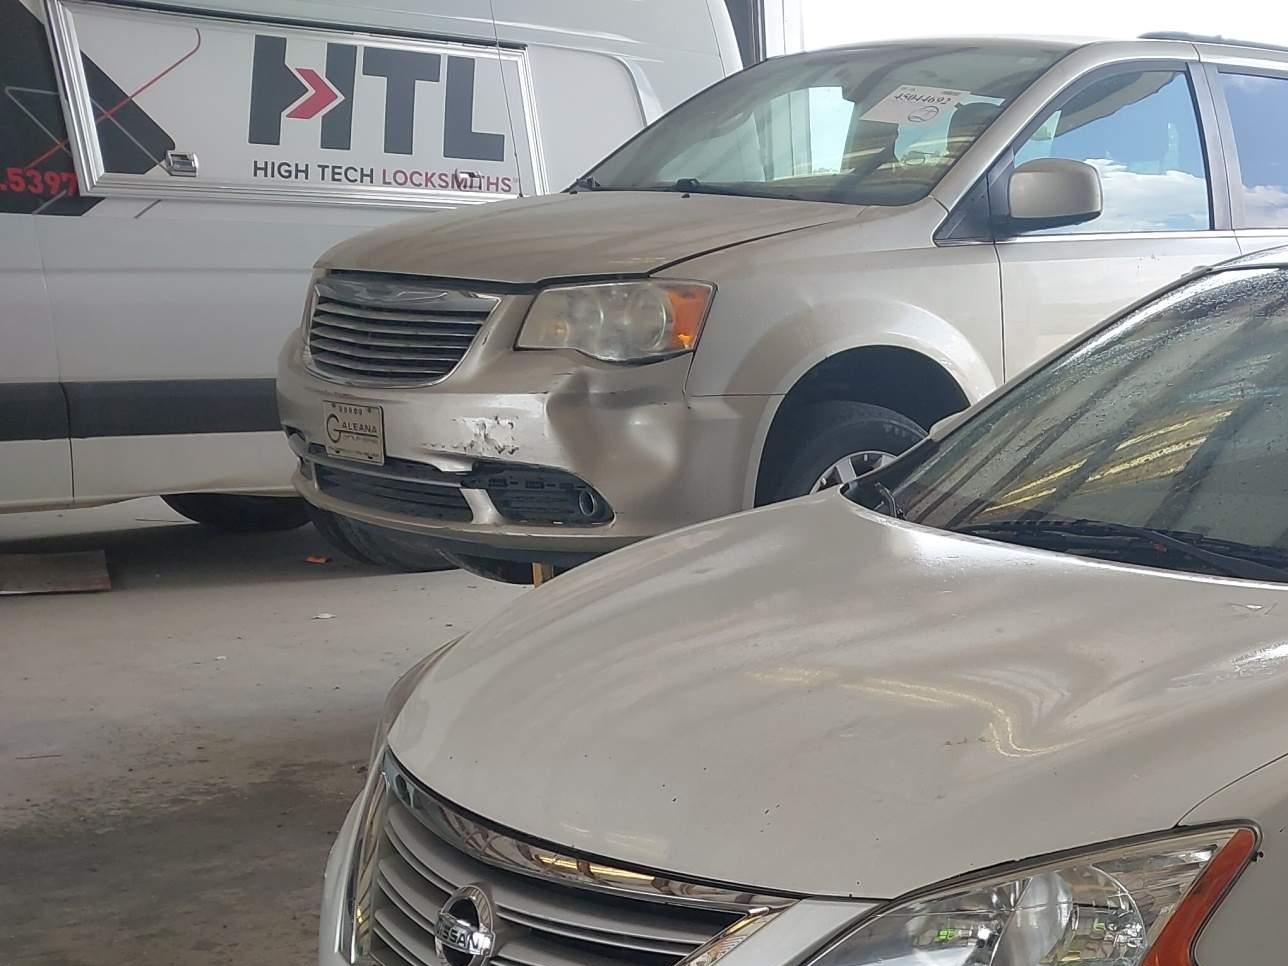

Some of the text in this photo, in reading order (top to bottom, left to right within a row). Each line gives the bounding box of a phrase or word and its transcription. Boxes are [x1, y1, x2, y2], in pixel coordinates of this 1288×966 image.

[248, 34, 505, 162] HTL
[253, 160, 512, 193] HIGH TECH LOCKSMITHS
[435, 918, 480, 951] SSAN
